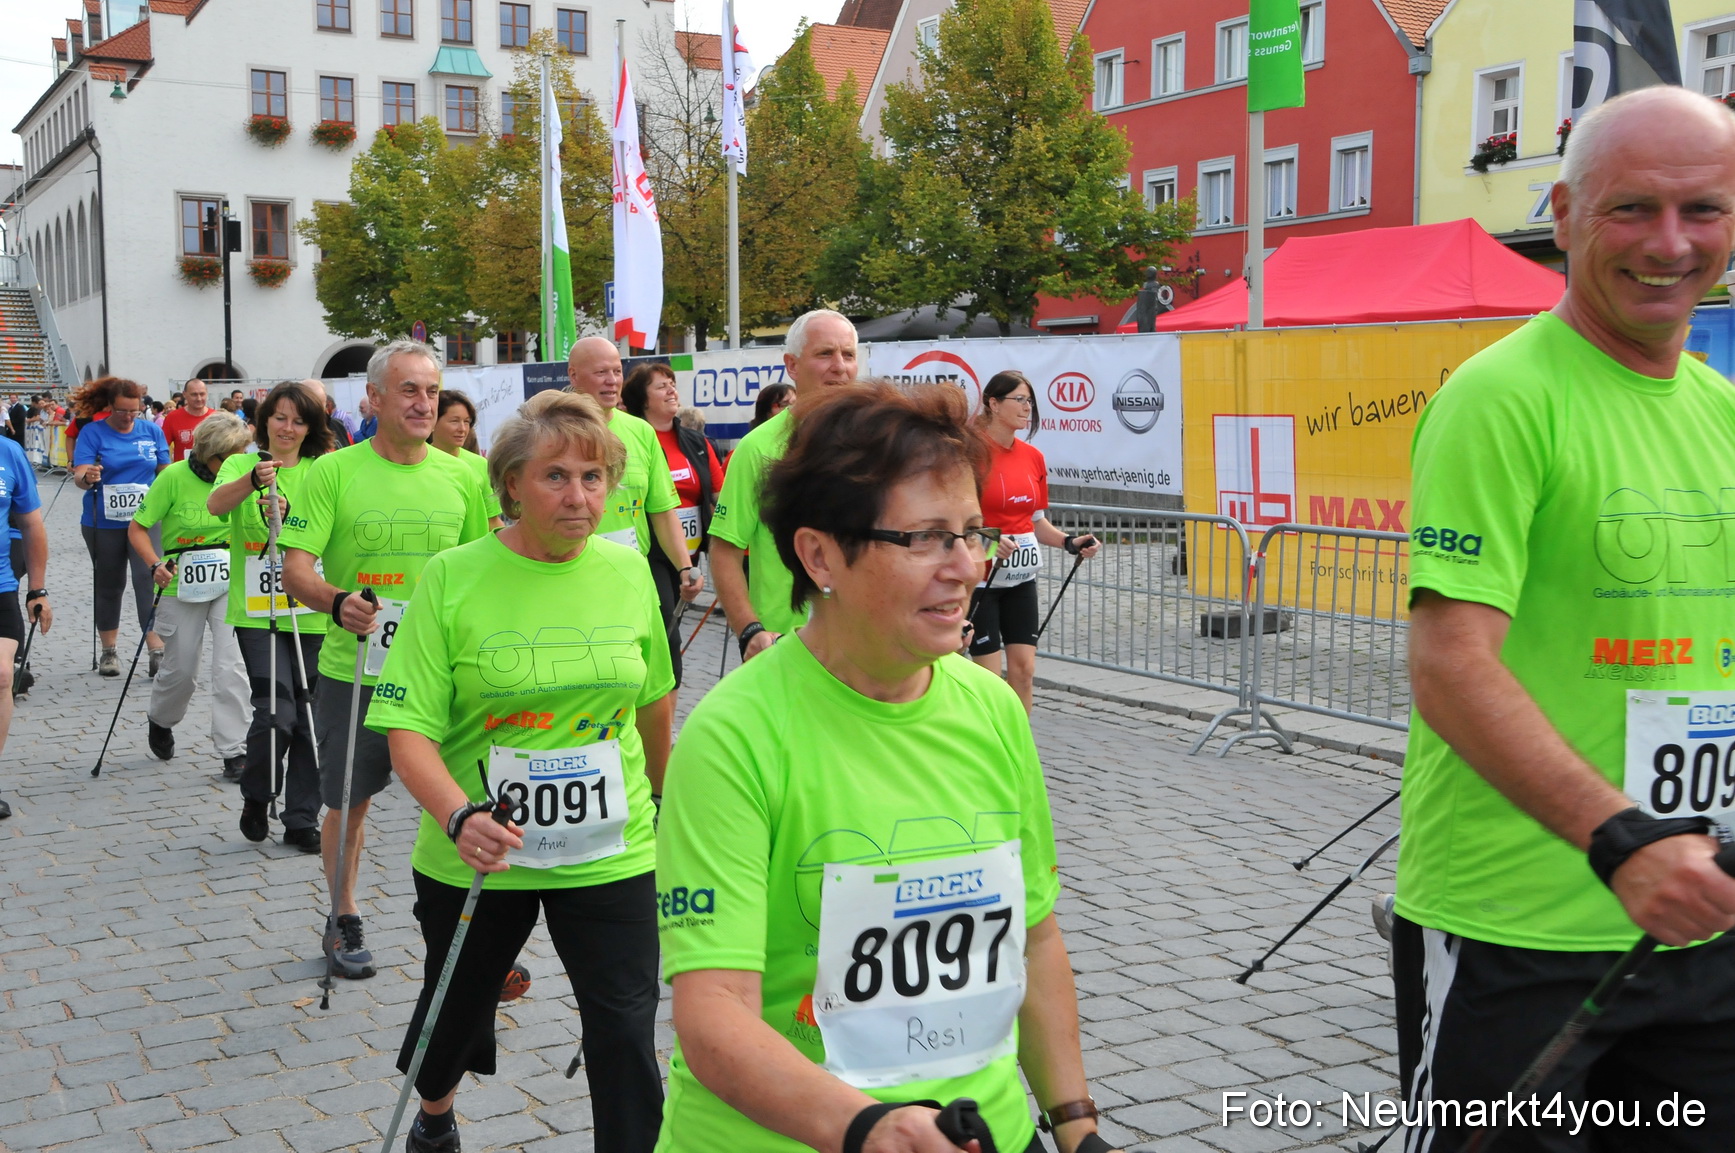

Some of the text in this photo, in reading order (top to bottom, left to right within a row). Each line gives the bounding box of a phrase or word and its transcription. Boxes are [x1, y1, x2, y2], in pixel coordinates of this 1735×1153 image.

[1056, 382, 1088, 402] KIA
[1116, 396, 1161, 407] NISSAN
[1306, 405, 1342, 436] wir
[1348, 389, 1427, 427] bauen
[1041, 418, 1103, 432] KIA MOTORS
[1054, 466, 1172, 488] www.gerhart-jaenig.de
[109, 493, 145, 509] 8024
[1309, 495, 1407, 534] MAX
[183, 562, 230, 584] 8075
[357, 571, 405, 586] MERZ
[1593, 637, 1695, 667] MERZ
[375, 682, 408, 702] eBa
[480, 690, 518, 700] Gebäude-
[520, 687, 536, 696] und
[537, 681, 628, 695] Automatisierungstechnik
[529, 755, 587, 773] BOCK
[506, 775, 609, 827] 8091
[895, 868, 984, 904] BOCK
[657, 886, 715, 918] eBa
[843, 906, 1013, 1003] 8097
[905, 1011, 967, 1055] Resi
